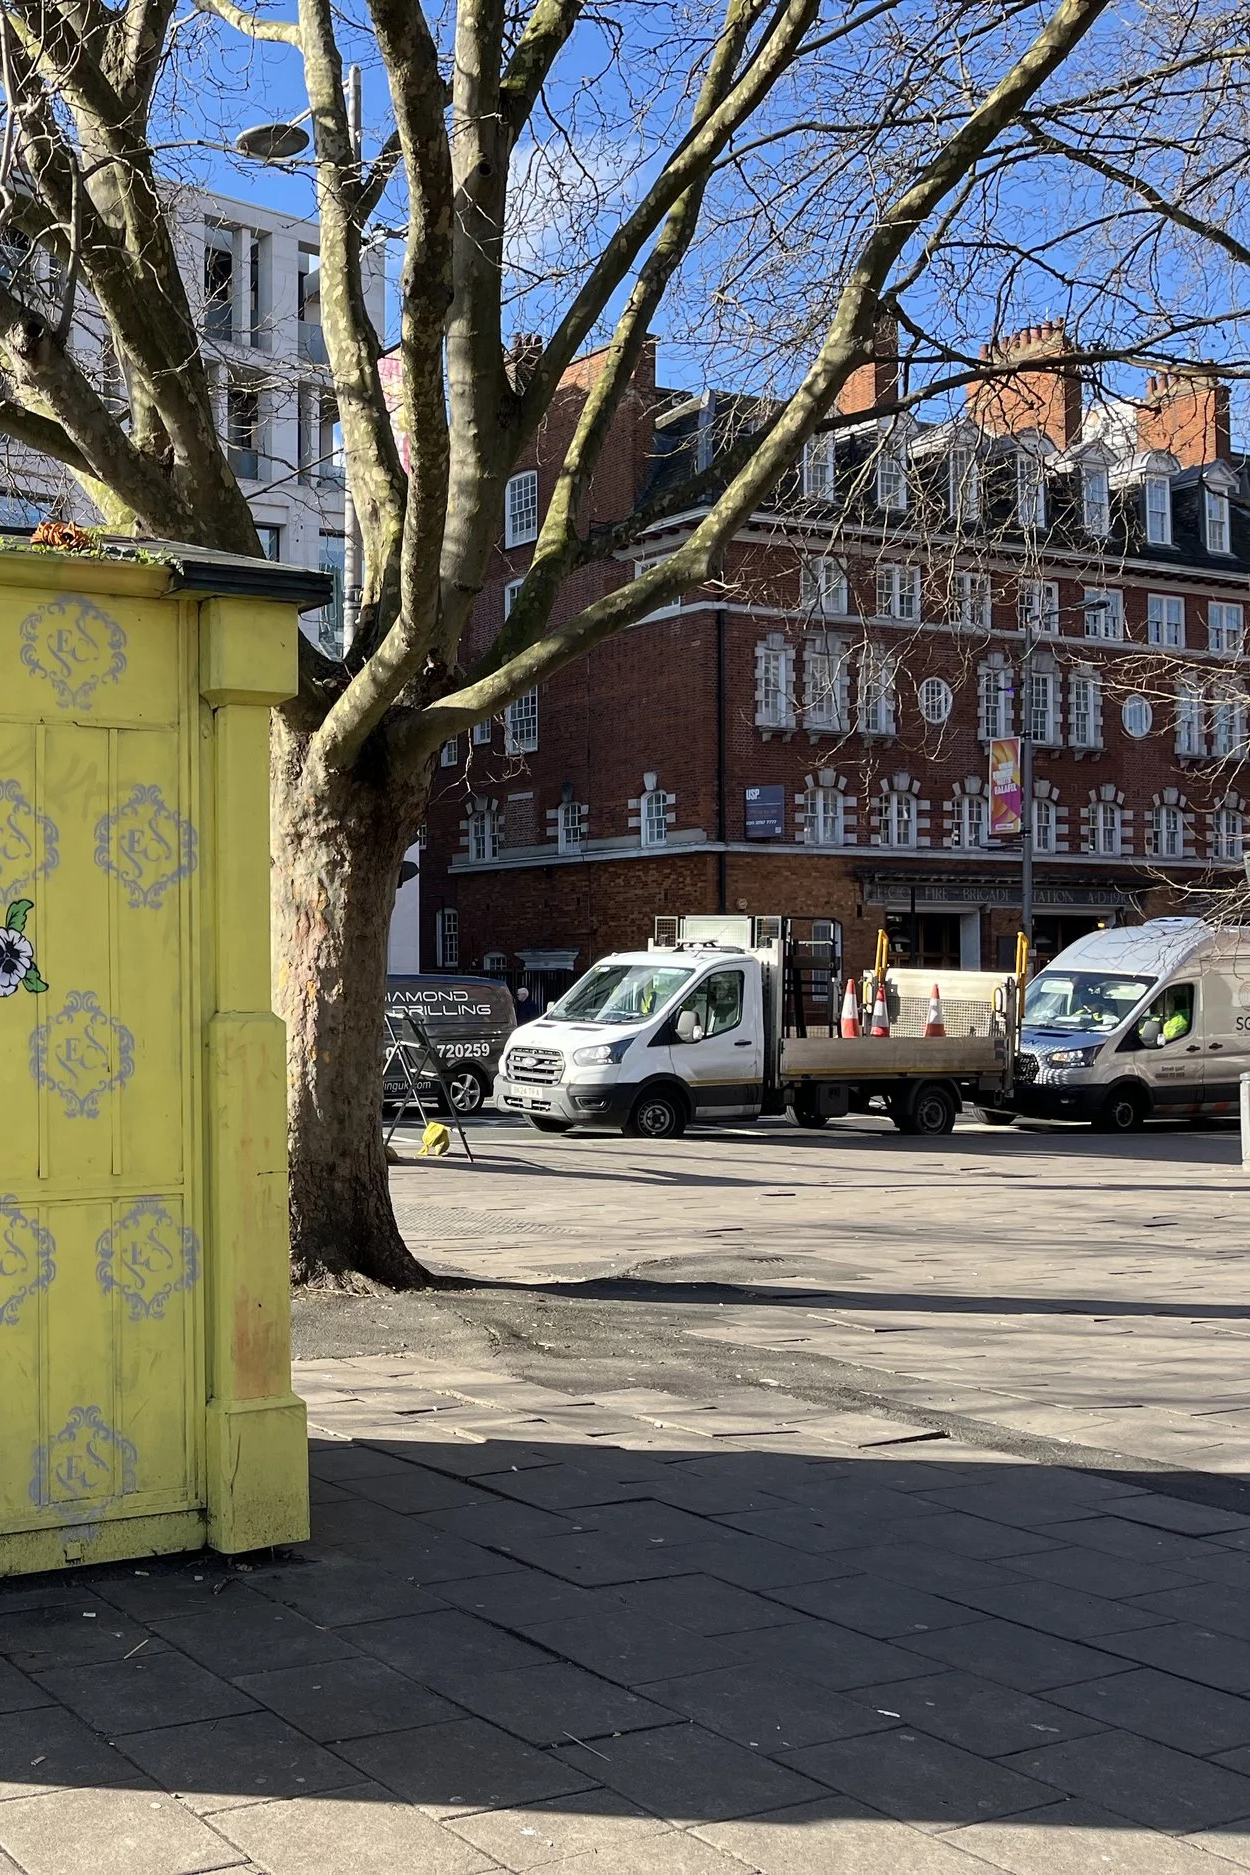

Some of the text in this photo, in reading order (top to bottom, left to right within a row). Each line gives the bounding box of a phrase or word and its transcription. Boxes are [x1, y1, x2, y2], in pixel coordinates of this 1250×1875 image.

[925, 886, 948, 900] FIRE
[963, 887, 1009, 901] BRIGADE
[1032, 889, 1074, 902] TATION
[385, 991, 469, 1002] IAMOND
[437, 1043, 490, 1058] 720259
